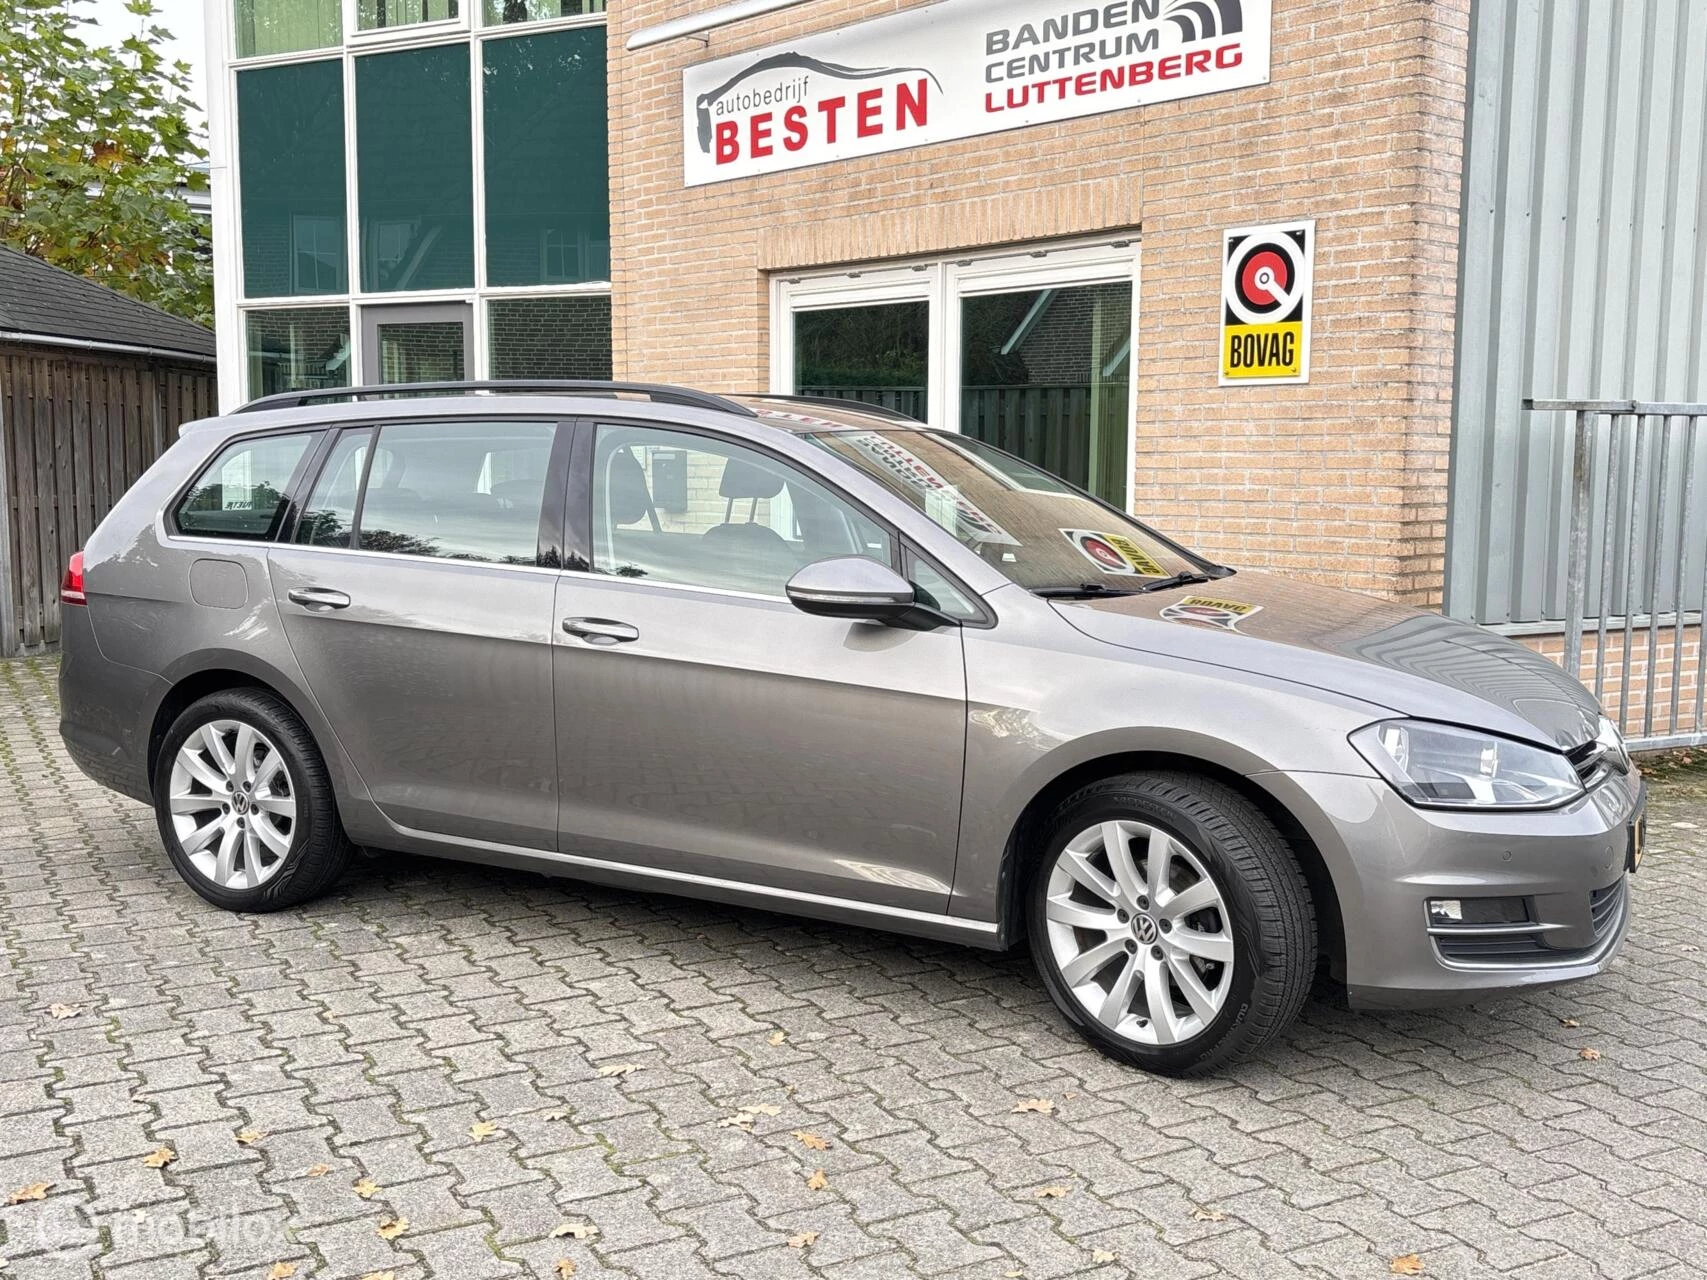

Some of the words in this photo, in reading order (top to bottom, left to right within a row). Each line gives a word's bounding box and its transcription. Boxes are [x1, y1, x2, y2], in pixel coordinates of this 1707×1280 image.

[985, 0, 1161, 56] BANDEN
[985, 28, 1160, 84] CENTRUM
[716, 75, 810, 116] autobedrijf
[985, 43, 1244, 114] LUTTENBERG
[715, 78, 928, 165] BESTEN
[1230, 331, 1295, 368] BOVAG
